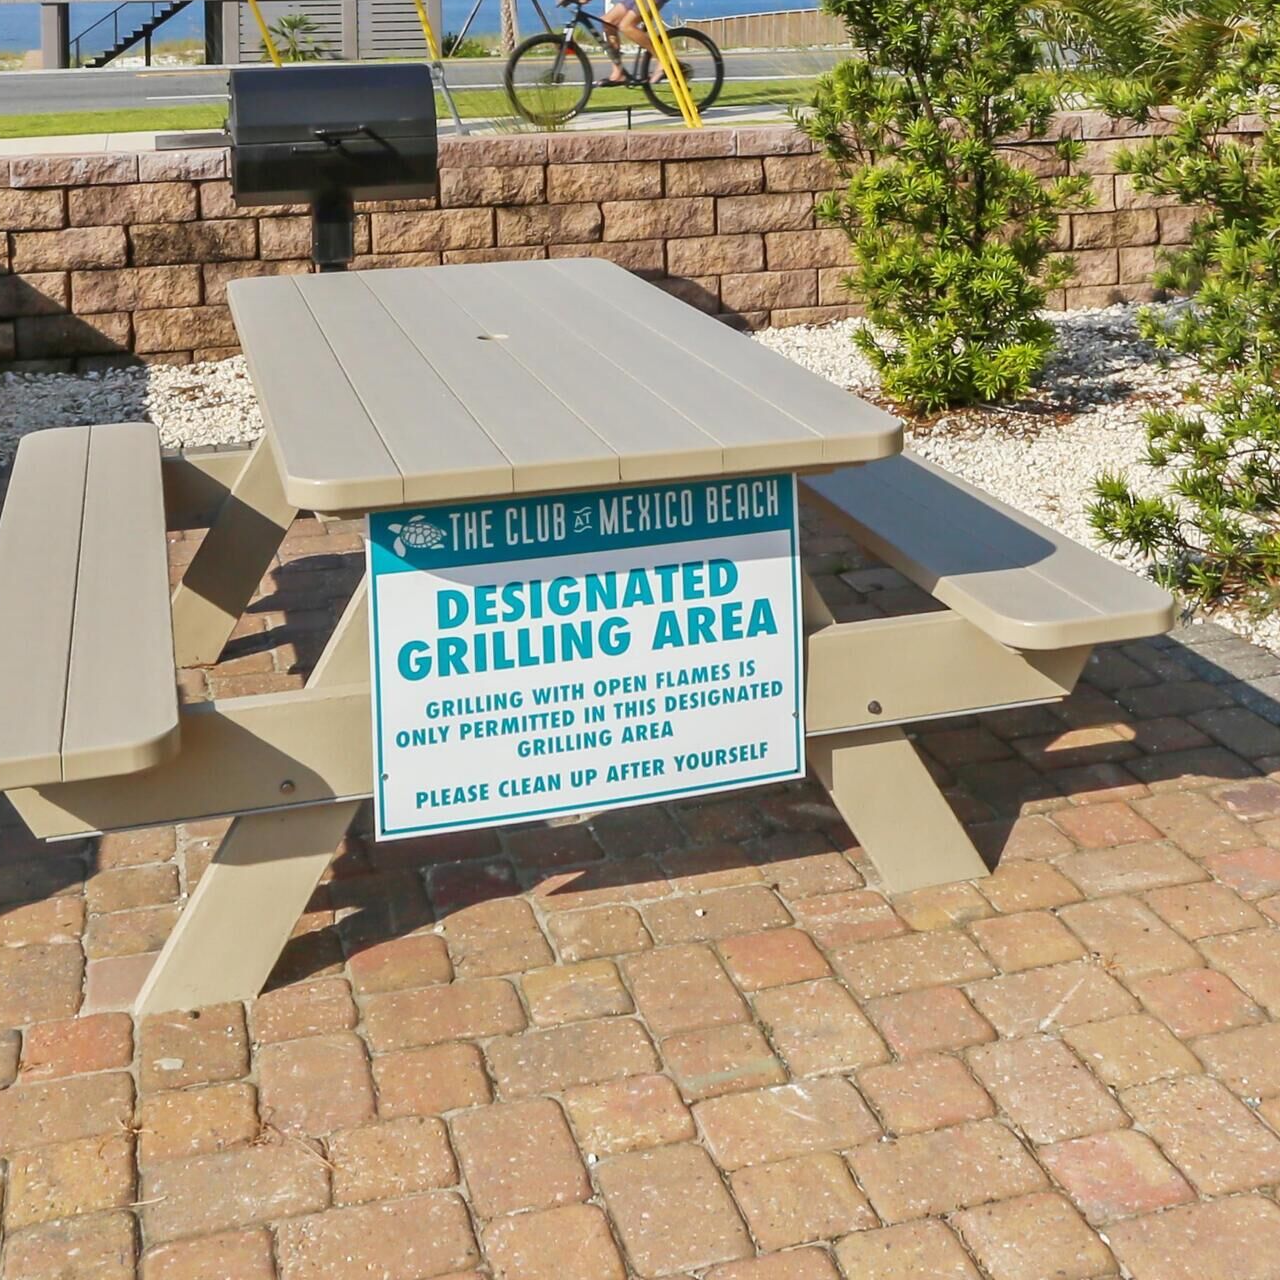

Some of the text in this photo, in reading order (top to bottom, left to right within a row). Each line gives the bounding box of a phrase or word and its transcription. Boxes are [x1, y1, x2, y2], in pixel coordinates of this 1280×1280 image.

[450, 480, 779, 551] THE CLUB AT MEXICO BEACH
[436, 557, 739, 630] DESIGNATED
[396, 597, 779, 681] GRILLING AREA
[395, 680, 784, 749] ONLY PERMITTED IN THIS DESIGNATED
[425, 660, 756, 720] GRILLING WITH OPEN FLAMES IS
[517, 720, 674, 758] GRILLING AREA
[415, 742, 769, 809] PLEASE CLEAN UP AFTER YOURSELF
